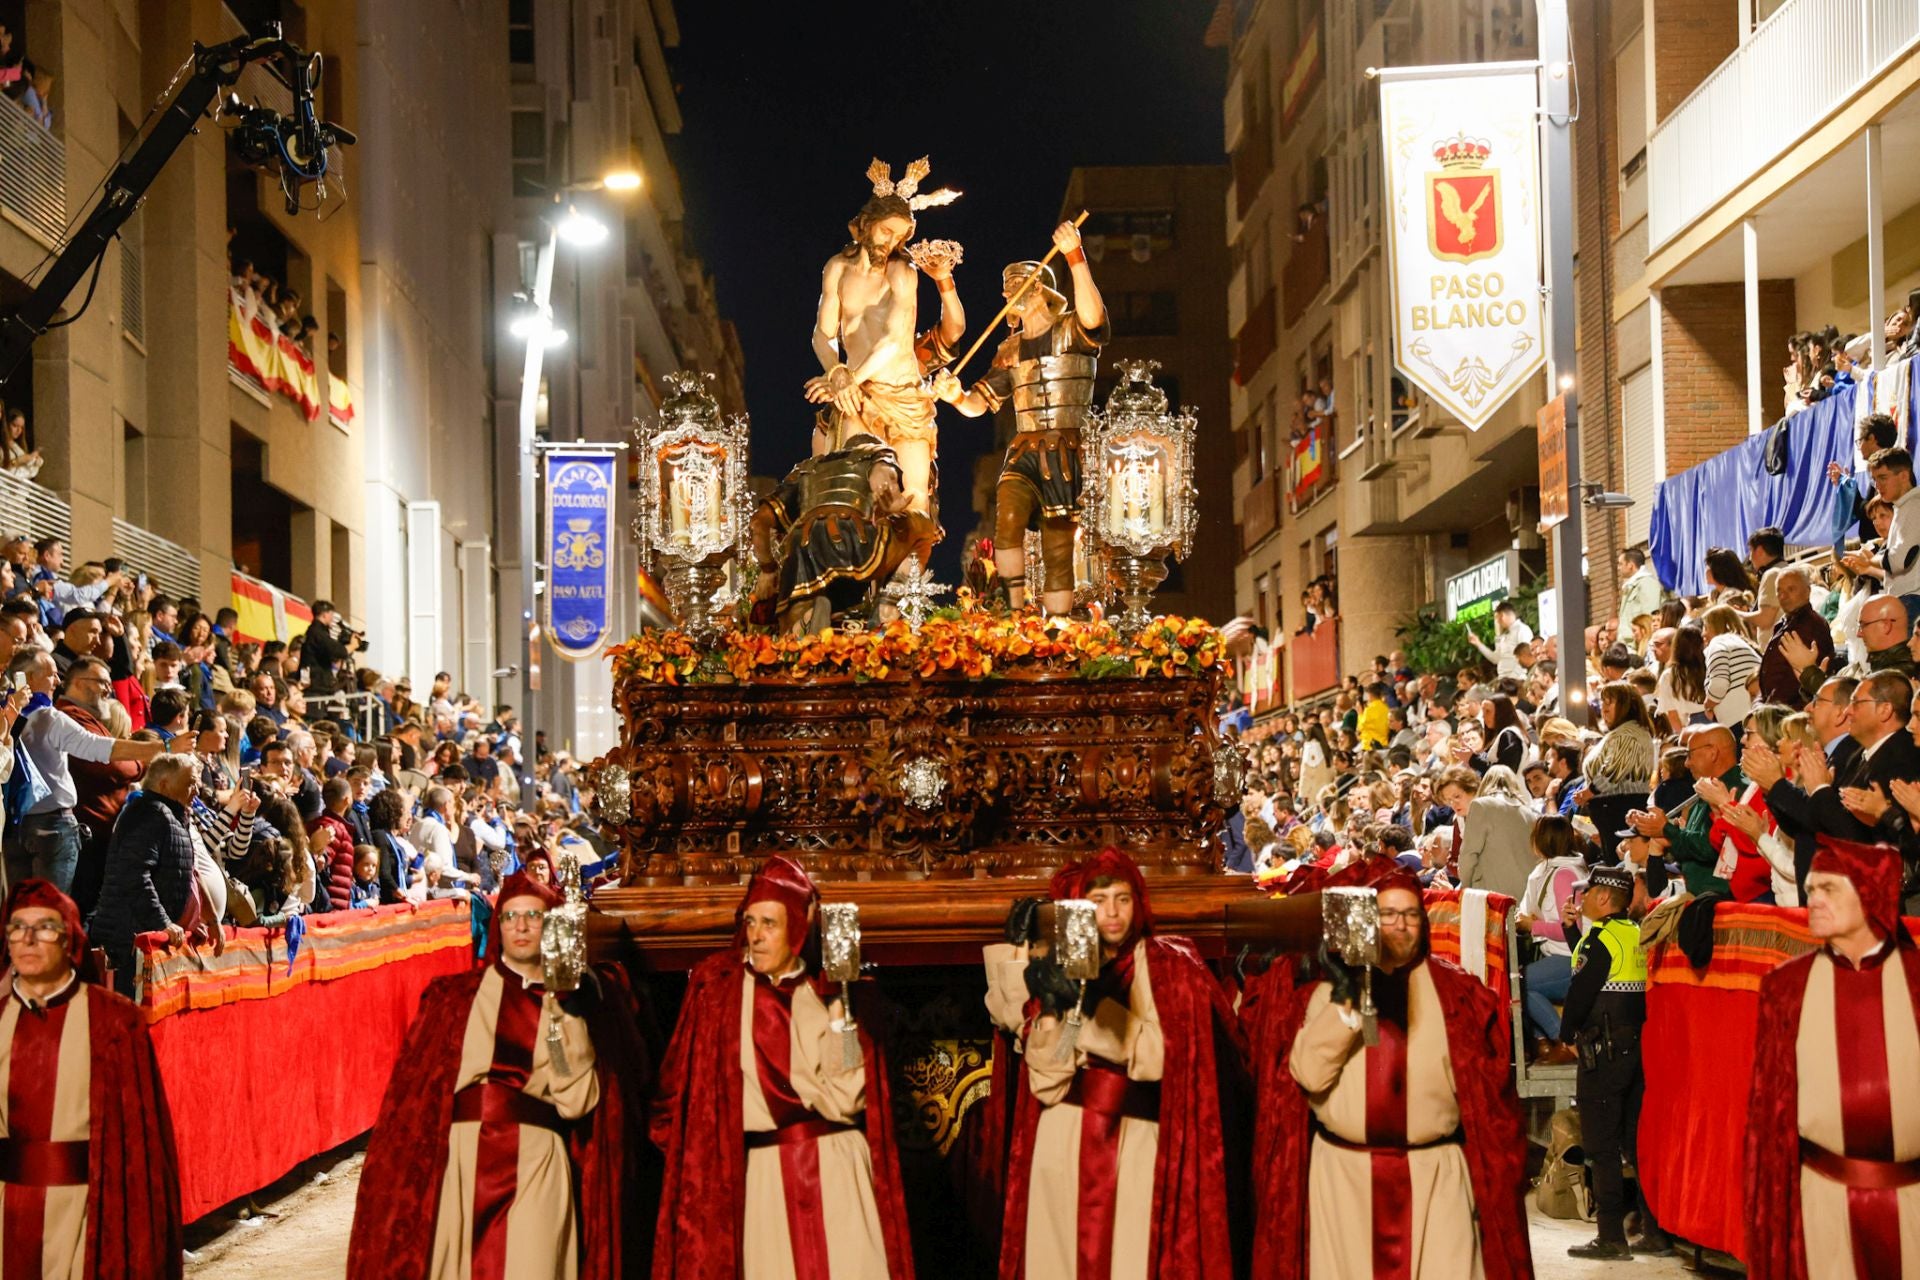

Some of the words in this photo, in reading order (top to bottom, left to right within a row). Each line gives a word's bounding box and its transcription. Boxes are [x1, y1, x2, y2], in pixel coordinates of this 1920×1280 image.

[1430, 271, 1504, 300] PASO
[1411, 299, 1526, 331] BLANCO
[559, 466, 602, 491] MATER
[553, 494, 606, 508] DOLOROSA
[1480, 558, 1508, 598] DENTAL
[553, 585, 577, 599] PASO
[578, 585, 605, 599] AZUL
